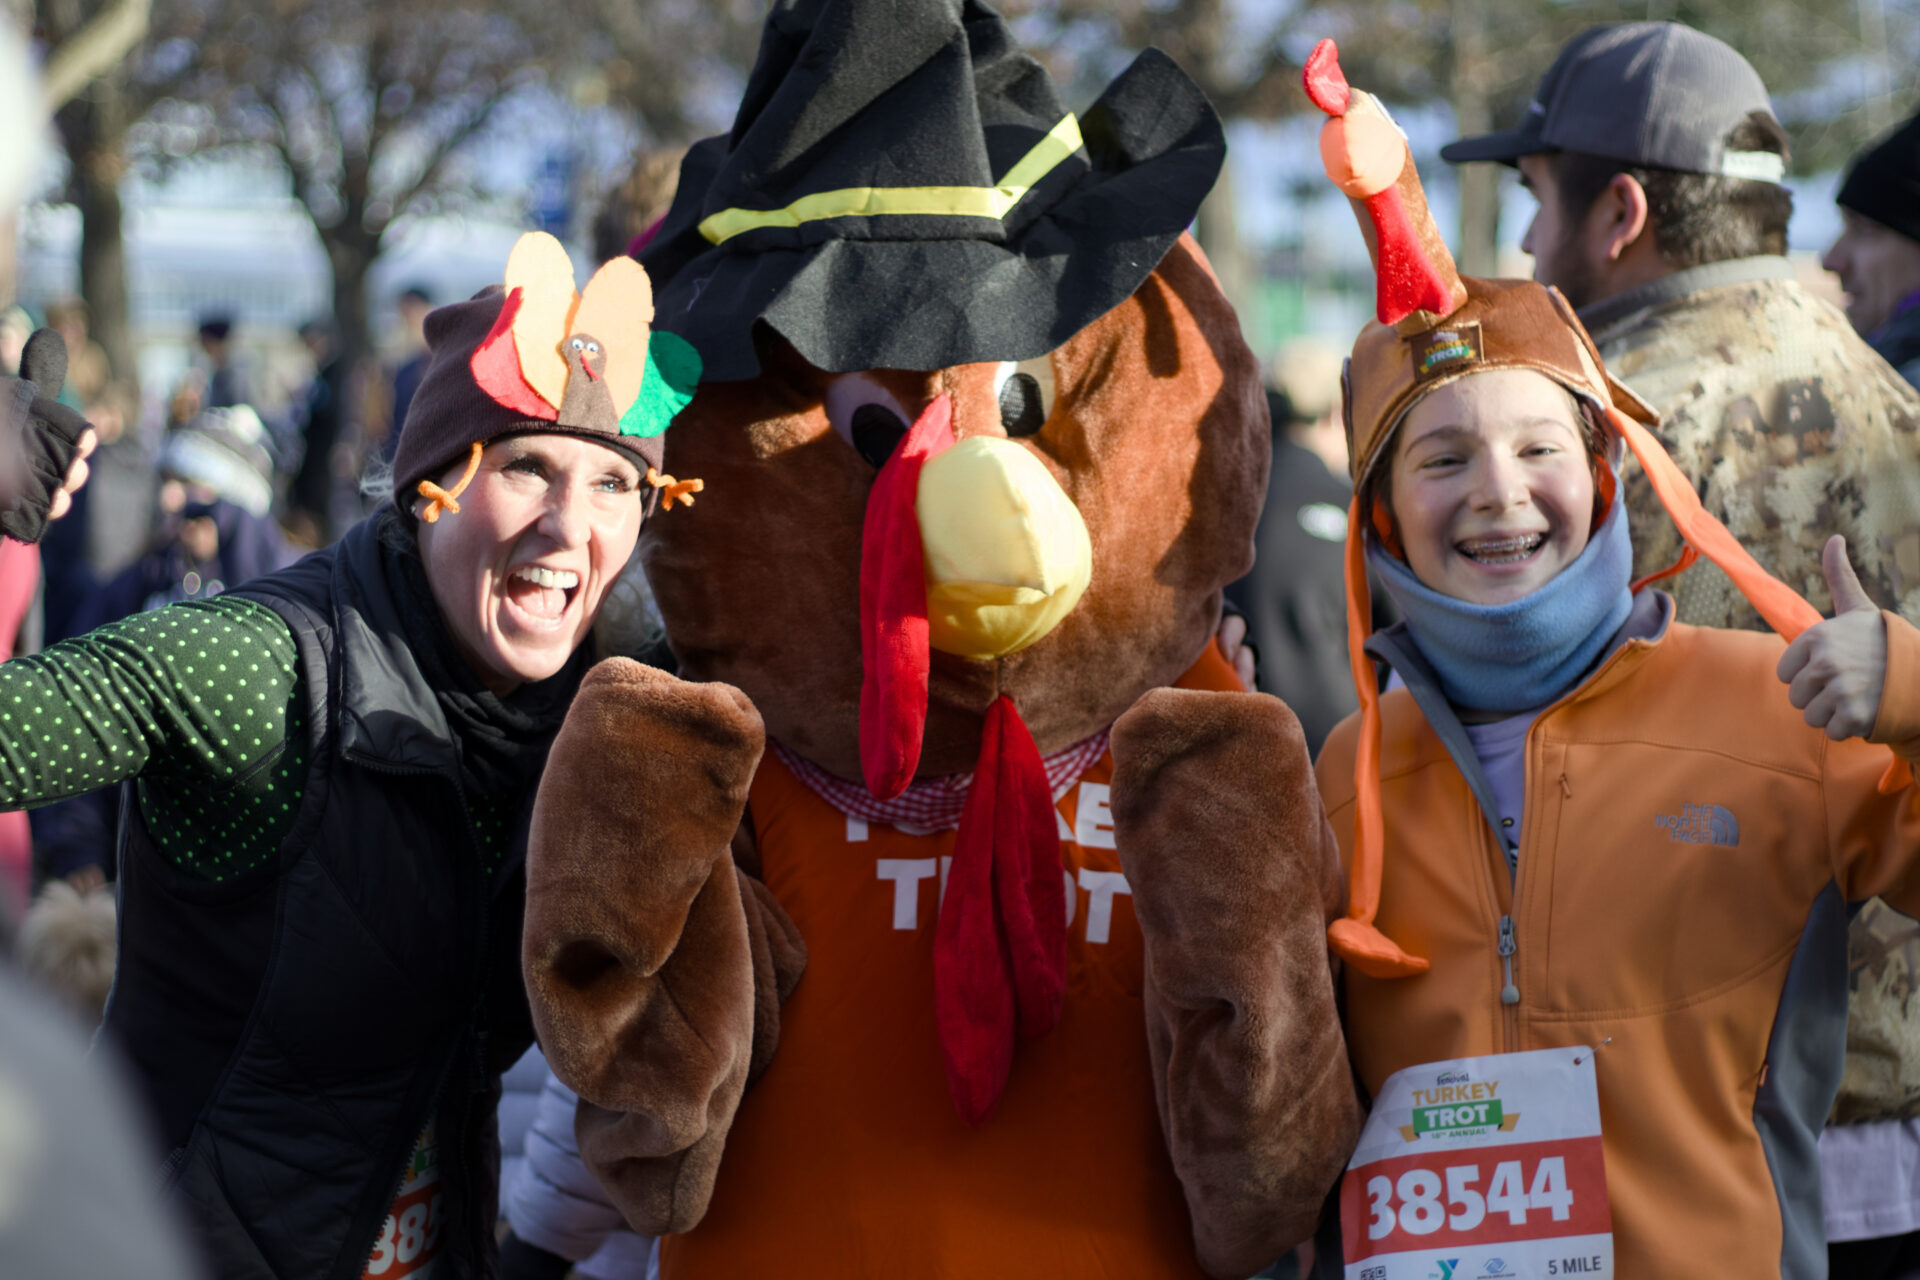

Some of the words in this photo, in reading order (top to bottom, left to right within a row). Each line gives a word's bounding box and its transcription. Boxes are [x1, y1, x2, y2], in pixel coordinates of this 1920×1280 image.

[1430, 347, 1464, 363] TROT
[1682, 803, 1712, 817] THE
[1656, 814, 1712, 832] NORTH
[1671, 830, 1712, 844] FACE
[1412, 1081, 1498, 1107] TURKEY
[1424, 1104, 1489, 1128] TROT
[1449, 1128, 1486, 1137] ANNUAL
[1367, 1156, 1574, 1240] 38544
[1548, 1260, 1558, 1275] 5
[1562, 1256, 1602, 1274] MILE
